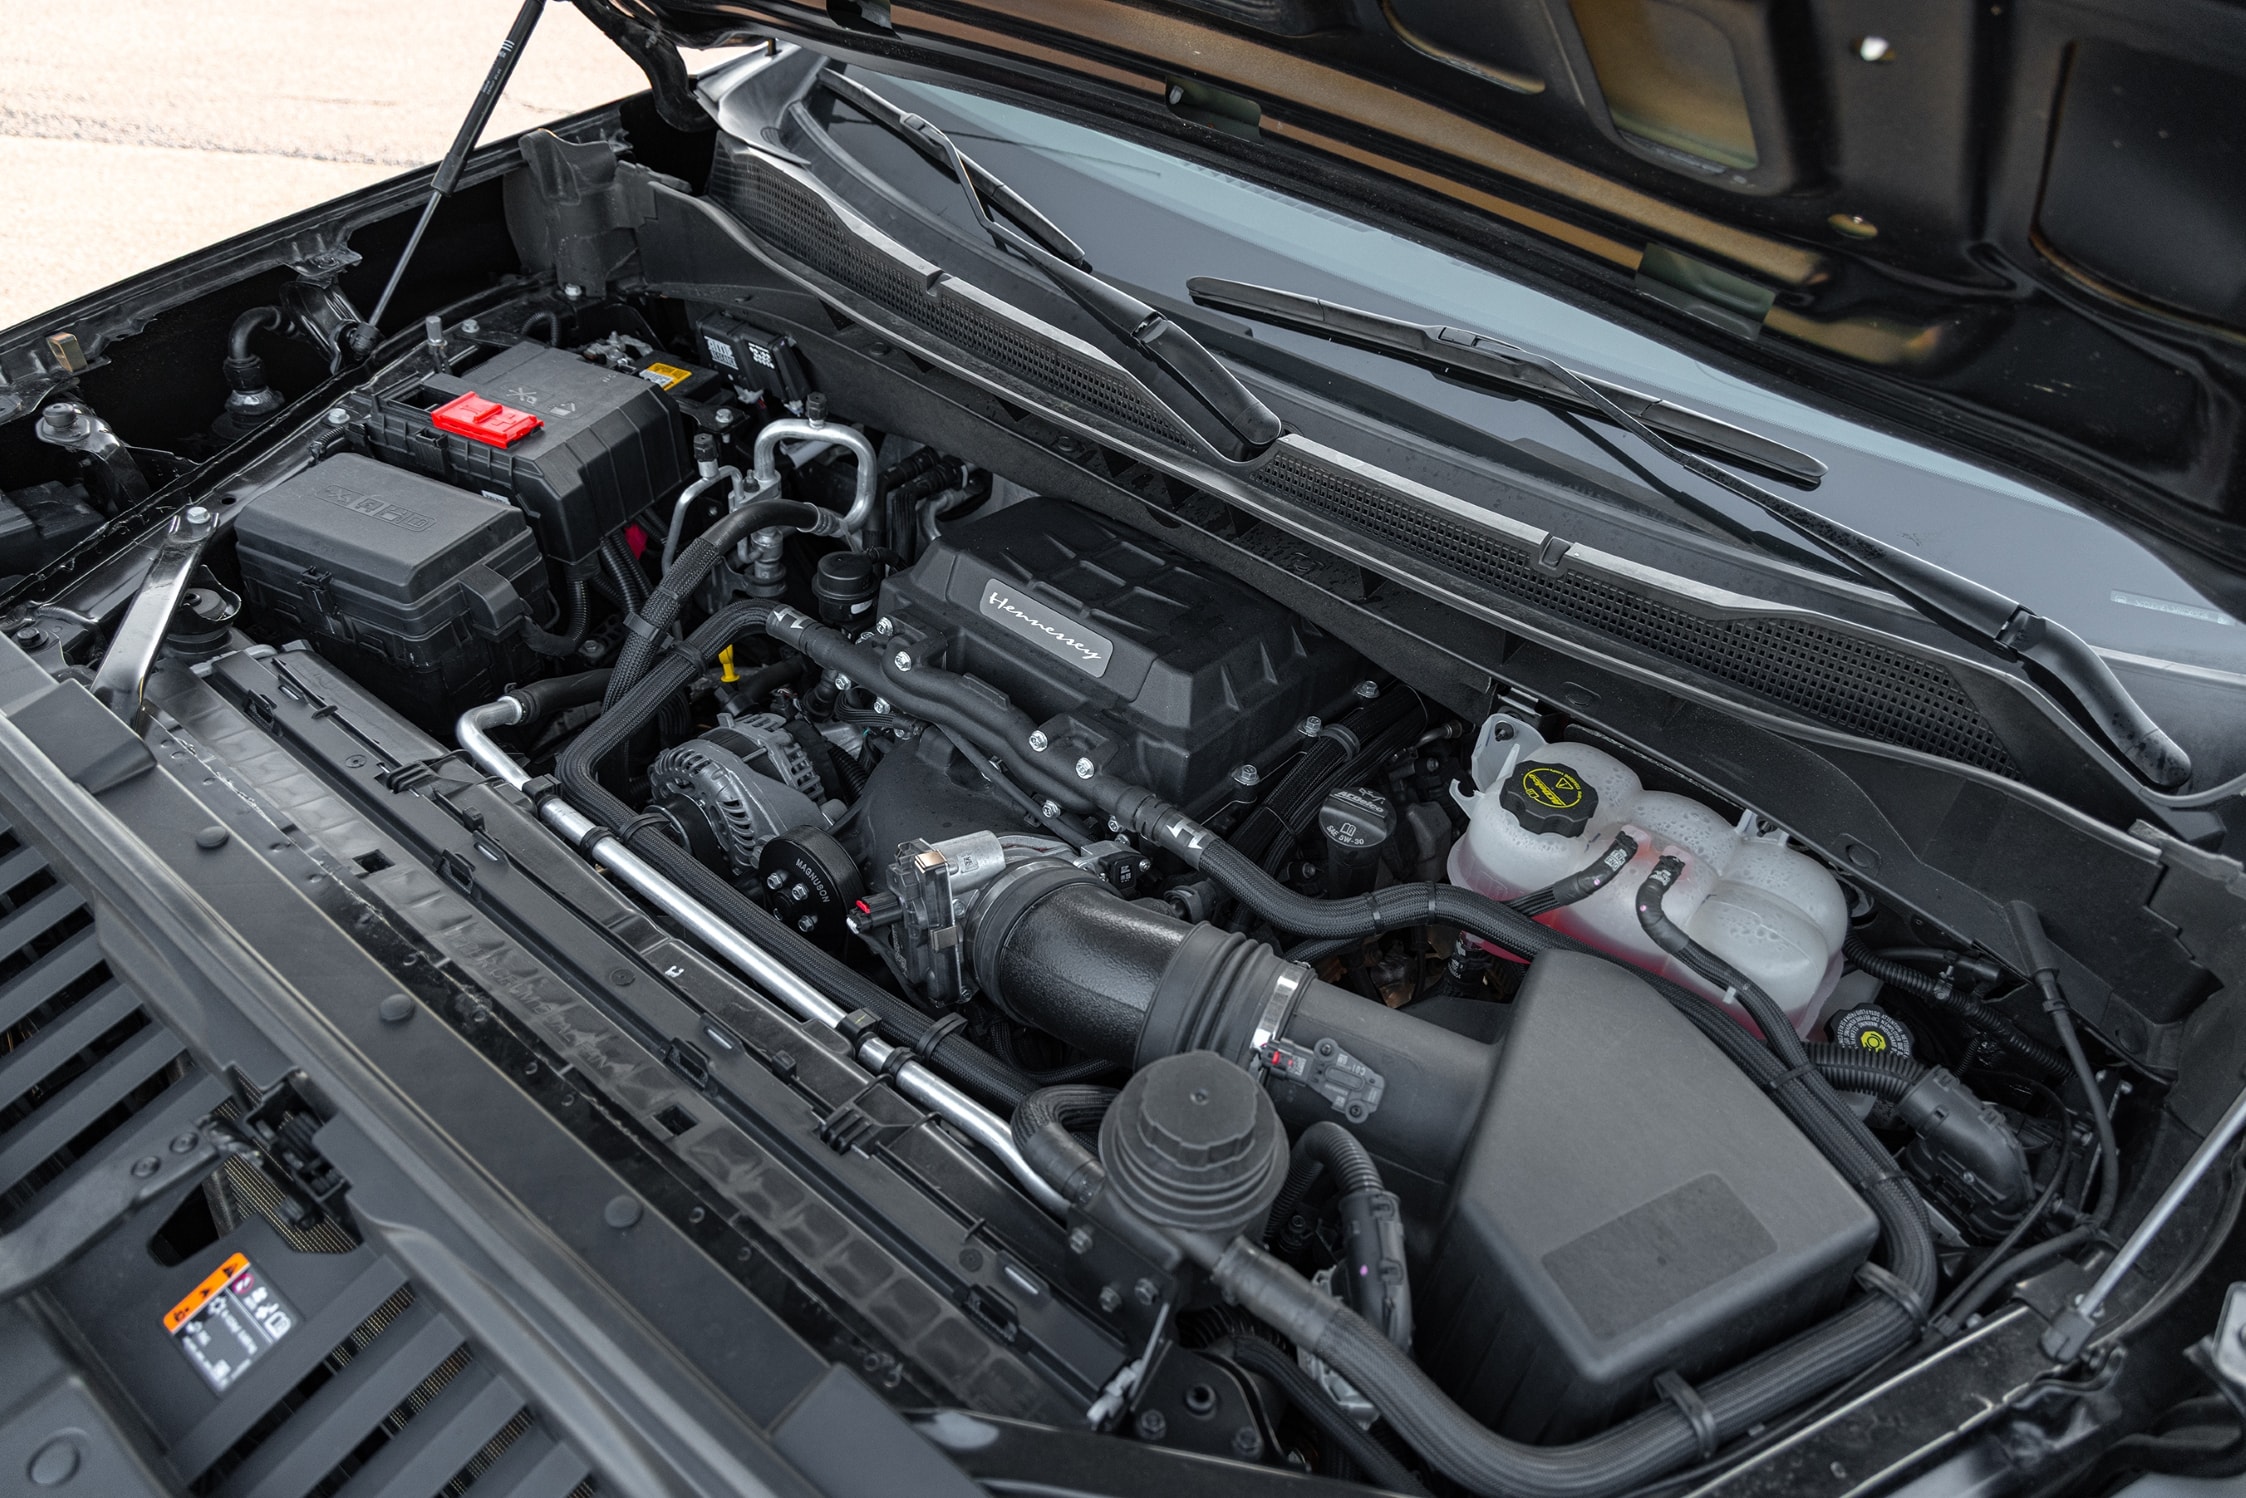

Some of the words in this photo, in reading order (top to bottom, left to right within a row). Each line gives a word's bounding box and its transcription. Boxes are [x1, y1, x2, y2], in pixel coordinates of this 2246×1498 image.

[989, 592, 1101, 659] Hennessey
[1334, 791, 1384, 812] ACDelco
[1326, 825, 1339, 837] SAE
[1338, 834, 1364, 845] 5W-30
[795, 858, 830, 903] MAGNUSON
